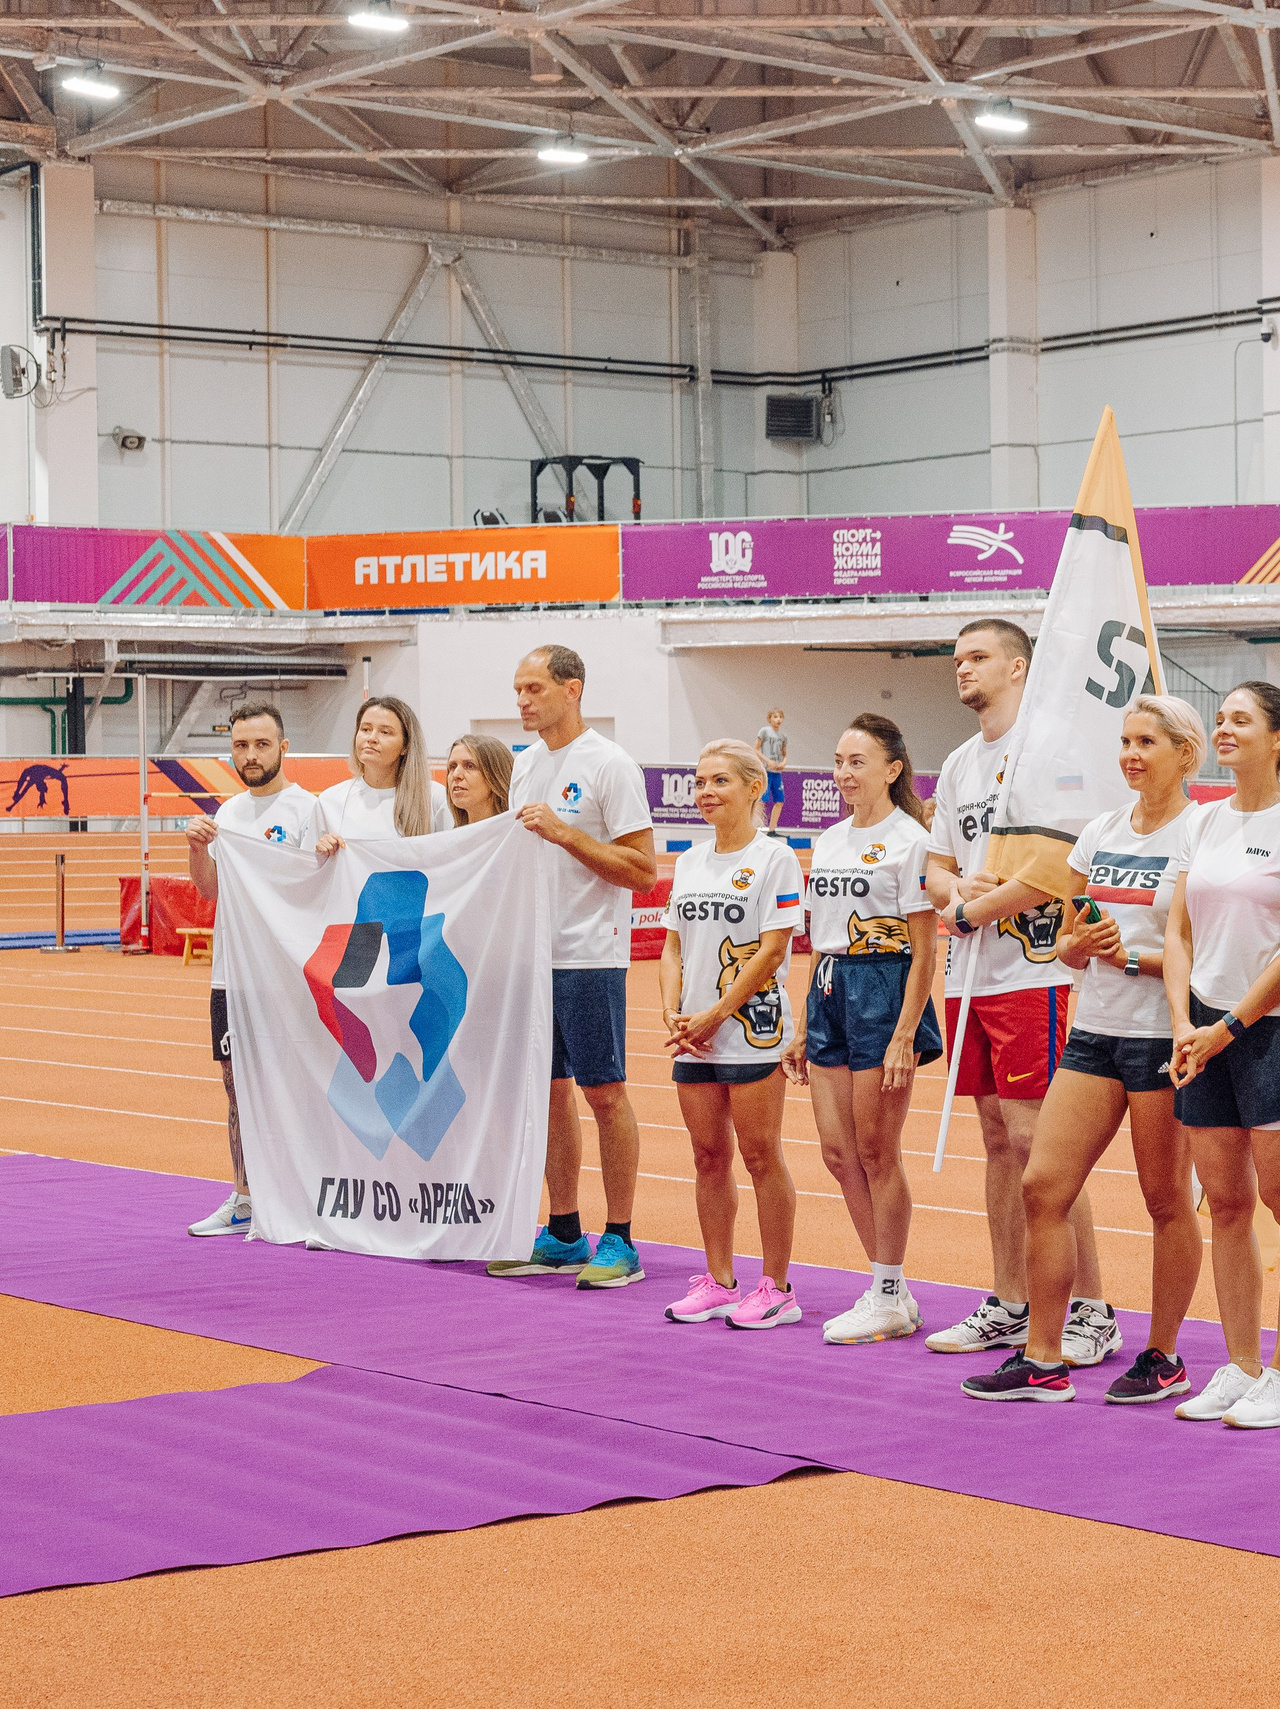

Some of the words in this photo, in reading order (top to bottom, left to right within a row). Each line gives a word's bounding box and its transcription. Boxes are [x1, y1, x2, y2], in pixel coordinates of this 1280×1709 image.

[833, 529, 872, 542] СПОРТ
[833, 542, 881, 556] НОРМА
[834, 555, 881, 570] ЖИЗНИ
[354, 550, 547, 595] АТЛЕТИКА
[1084, 620, 1155, 709] S
[802, 779, 834, 790] СПОРТ
[803, 790, 840, 800] НОРМА
[802, 800, 840, 811] ЖИЗНИ
[1245, 846, 1271, 858] DAVIS
[317, 1177, 366, 1220] ГАУ
[372, 1180, 402, 1222] СО
[408, 1182, 496, 1225] «АРЕНА»
